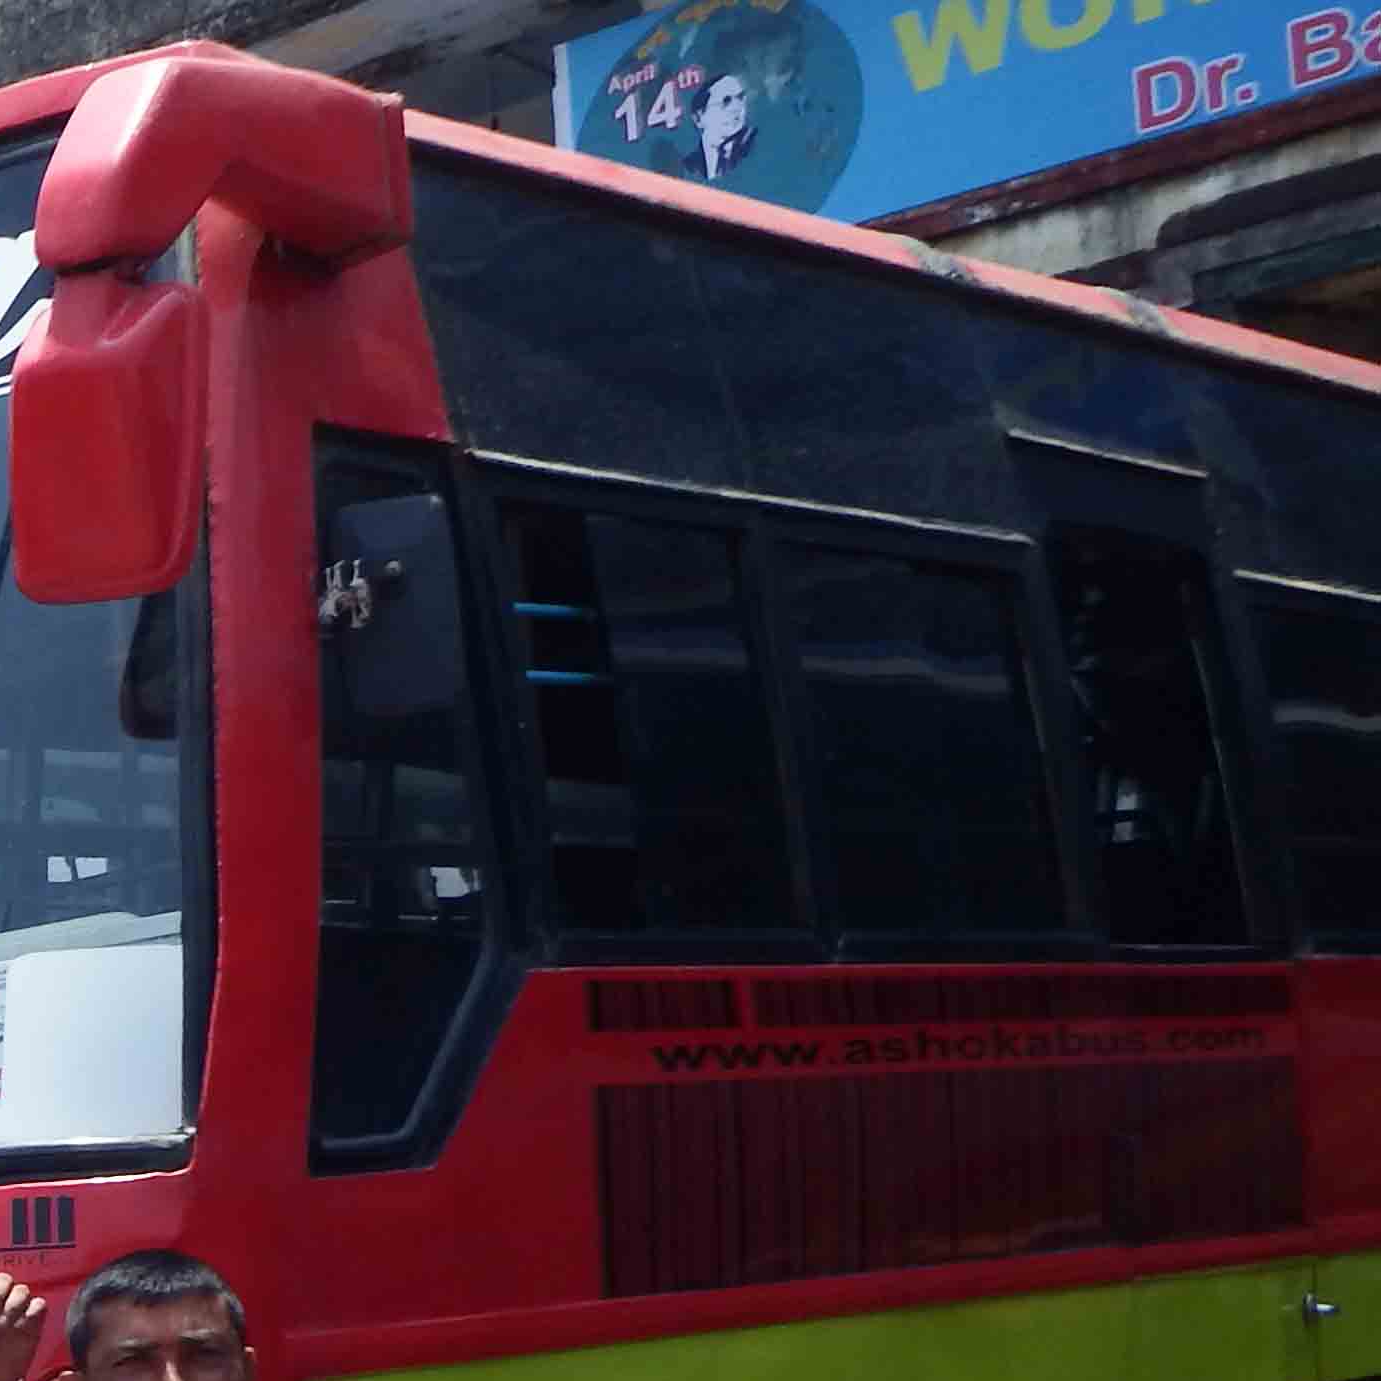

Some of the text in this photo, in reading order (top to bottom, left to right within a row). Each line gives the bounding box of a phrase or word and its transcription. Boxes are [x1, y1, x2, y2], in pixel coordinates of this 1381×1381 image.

[607, 63, 656, 96] April
[615, 64, 704, 142] 14th
[1133, 54, 1256, 133] Dr.
[650, 1022, 1268, 1074] www.ashokabus.com
[8, 1195, 76, 1246] III
